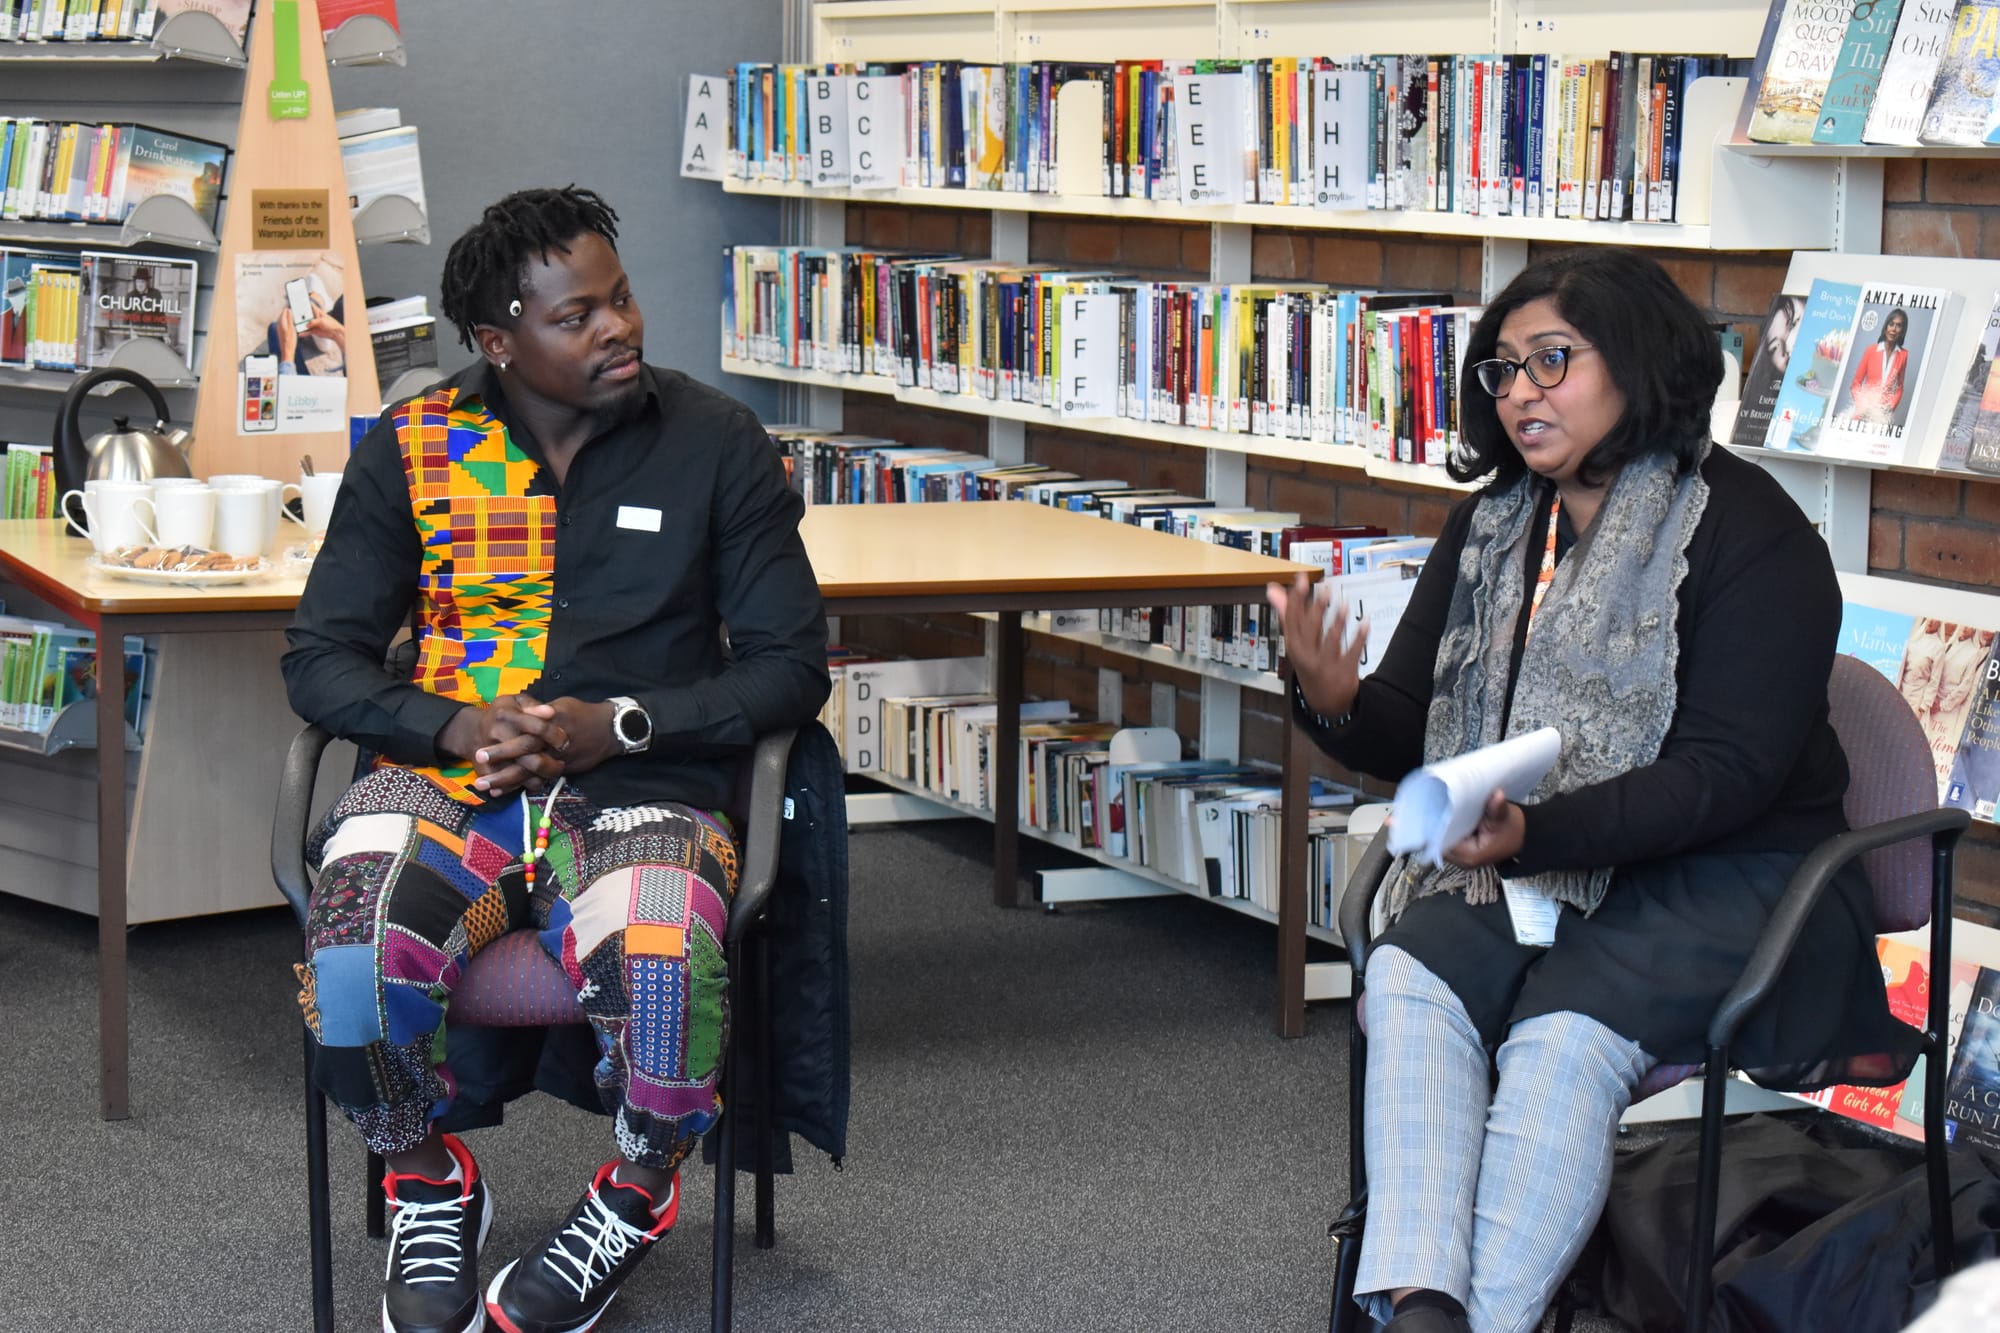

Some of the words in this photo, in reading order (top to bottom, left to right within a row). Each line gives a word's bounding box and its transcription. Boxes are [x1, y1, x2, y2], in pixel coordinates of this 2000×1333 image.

[1947, 4, 2000, 60] PA
[698, 81, 712, 98] A
[818, 81, 831, 100] B
[857, 81, 870, 100] C
[1189, 83, 1202, 105] E
[1324, 78, 1339, 101] H
[695, 112, 708, 130] A
[1664, 90, 1675, 138] afloat
[819, 115, 832, 134] B
[858, 116, 871, 135] C
[1324, 122, 1339, 145] H
[153, 138, 179, 152] Carol
[1191, 124, 1204, 146] E
[134, 144, 196, 167] Drinkwater
[692, 144, 705, 161] A
[821, 150, 834, 168] B
[859, 151, 872, 170] C
[1193, 165, 1207, 186] E
[1324, 165, 1339, 188] H
[258, 201, 275, 209] With
[277, 201, 300, 210] thanks
[302, 202, 309, 210] to
[311, 202, 323, 210] the
[262, 215, 293, 226] Friends
[294, 215, 304, 226] of
[306, 216, 320, 226] the
[257, 228, 295, 242] Warragul
[296, 228, 325, 241] Library
[99, 294, 183, 314] CHURCHILL
[1820, 290, 1842, 307] Bring
[1863, 289, 1905, 308] ANITA
[1908, 294, 1939, 311] HILL
[1075, 300, 1087, 321] F
[1075, 338, 1087, 359] F
[1075, 376, 1087, 397] F
[1829, 415, 1904, 438] BELIEVING
[1355, 599, 1364, 622] J
[857, 683, 871, 700] D
[857, 716, 871, 734] D
[858, 750, 872, 768] D
[1843, 1092, 1870, 1113] Girls
[1870, 1101, 1891, 1119] Are
[1963, 1085, 1976, 1102] A
[1984, 1090, 2000, 1109] C
[1946, 1100, 1985, 1126] RUN
